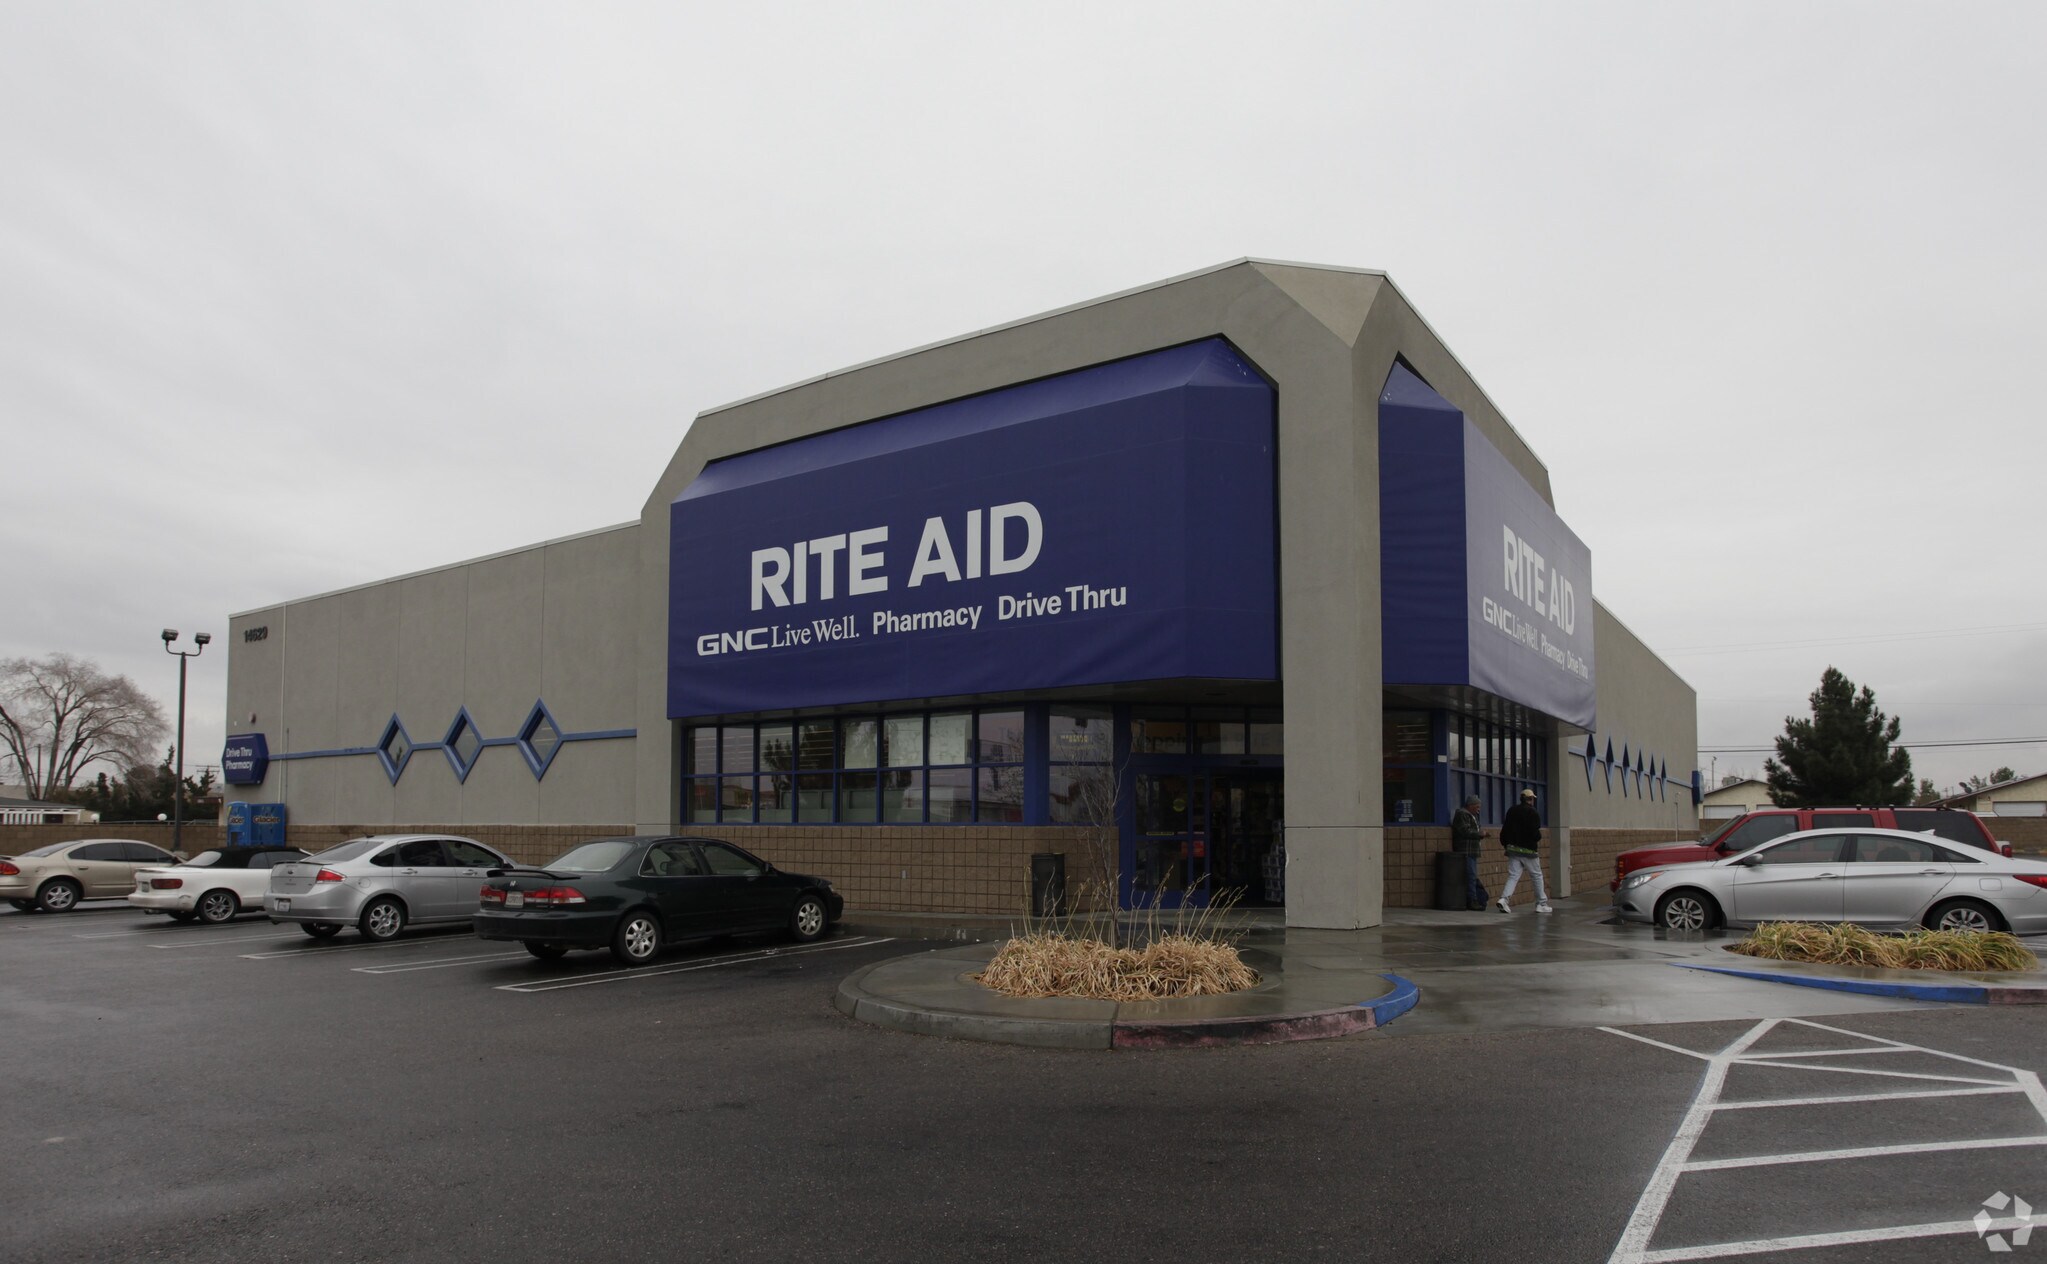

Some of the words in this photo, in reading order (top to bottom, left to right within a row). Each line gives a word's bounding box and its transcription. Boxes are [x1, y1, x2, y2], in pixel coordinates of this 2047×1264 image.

[752, 526, 888, 610] RITE
[908, 502, 1042, 587] AID
[1503, 524, 1546, 617] RITE
[1549, 567, 1575, 636] AID
[697, 628, 768, 656] GNC
[873, 605, 982, 635] Pharmacy
[998, 592, 1062, 620] Drive
[1065, 584, 1127, 612] Thru
[1483, 596, 1512, 635] GNC
[1541, 632, 1565, 671] Pharmacy
[1567, 650, 1579, 674] Drive
[1578, 656, 1588, 680] Thru
[225, 747, 240, 757] Drive
[240, 746, 252, 757] Thru
[225, 760, 253, 771] Pharmacy
[252, 815, 281, 825] Glacier
